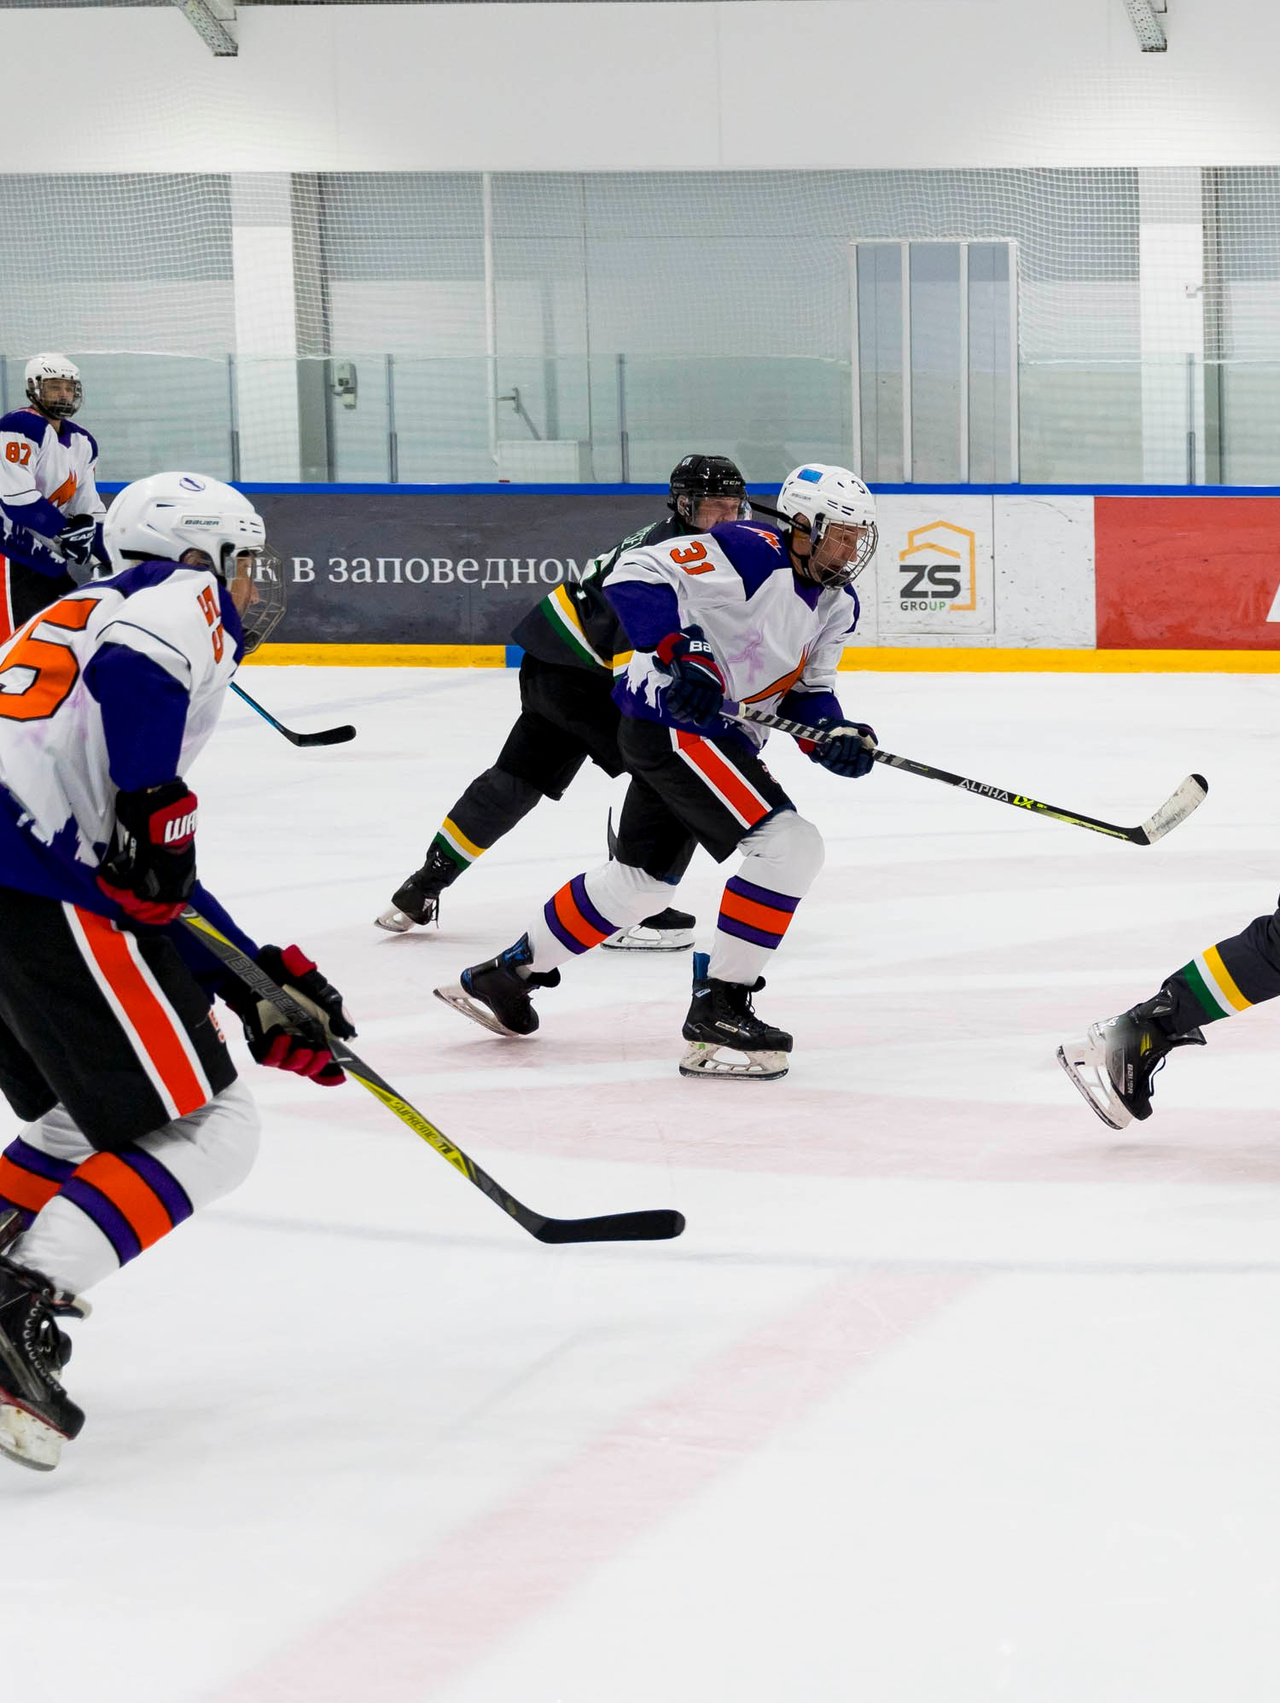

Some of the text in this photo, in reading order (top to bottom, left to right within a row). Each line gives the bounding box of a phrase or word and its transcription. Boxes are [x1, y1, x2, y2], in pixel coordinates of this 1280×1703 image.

[5, 441, 31, 466] 87
[292, 556, 316, 583] в
[669, 540, 716, 576] 31
[899, 564, 962, 599] ZS
[900, 601, 947, 611] GROUP
[958, 777, 1010, 803] ALPHA
[390, 1101, 438, 1141] SUPREME
